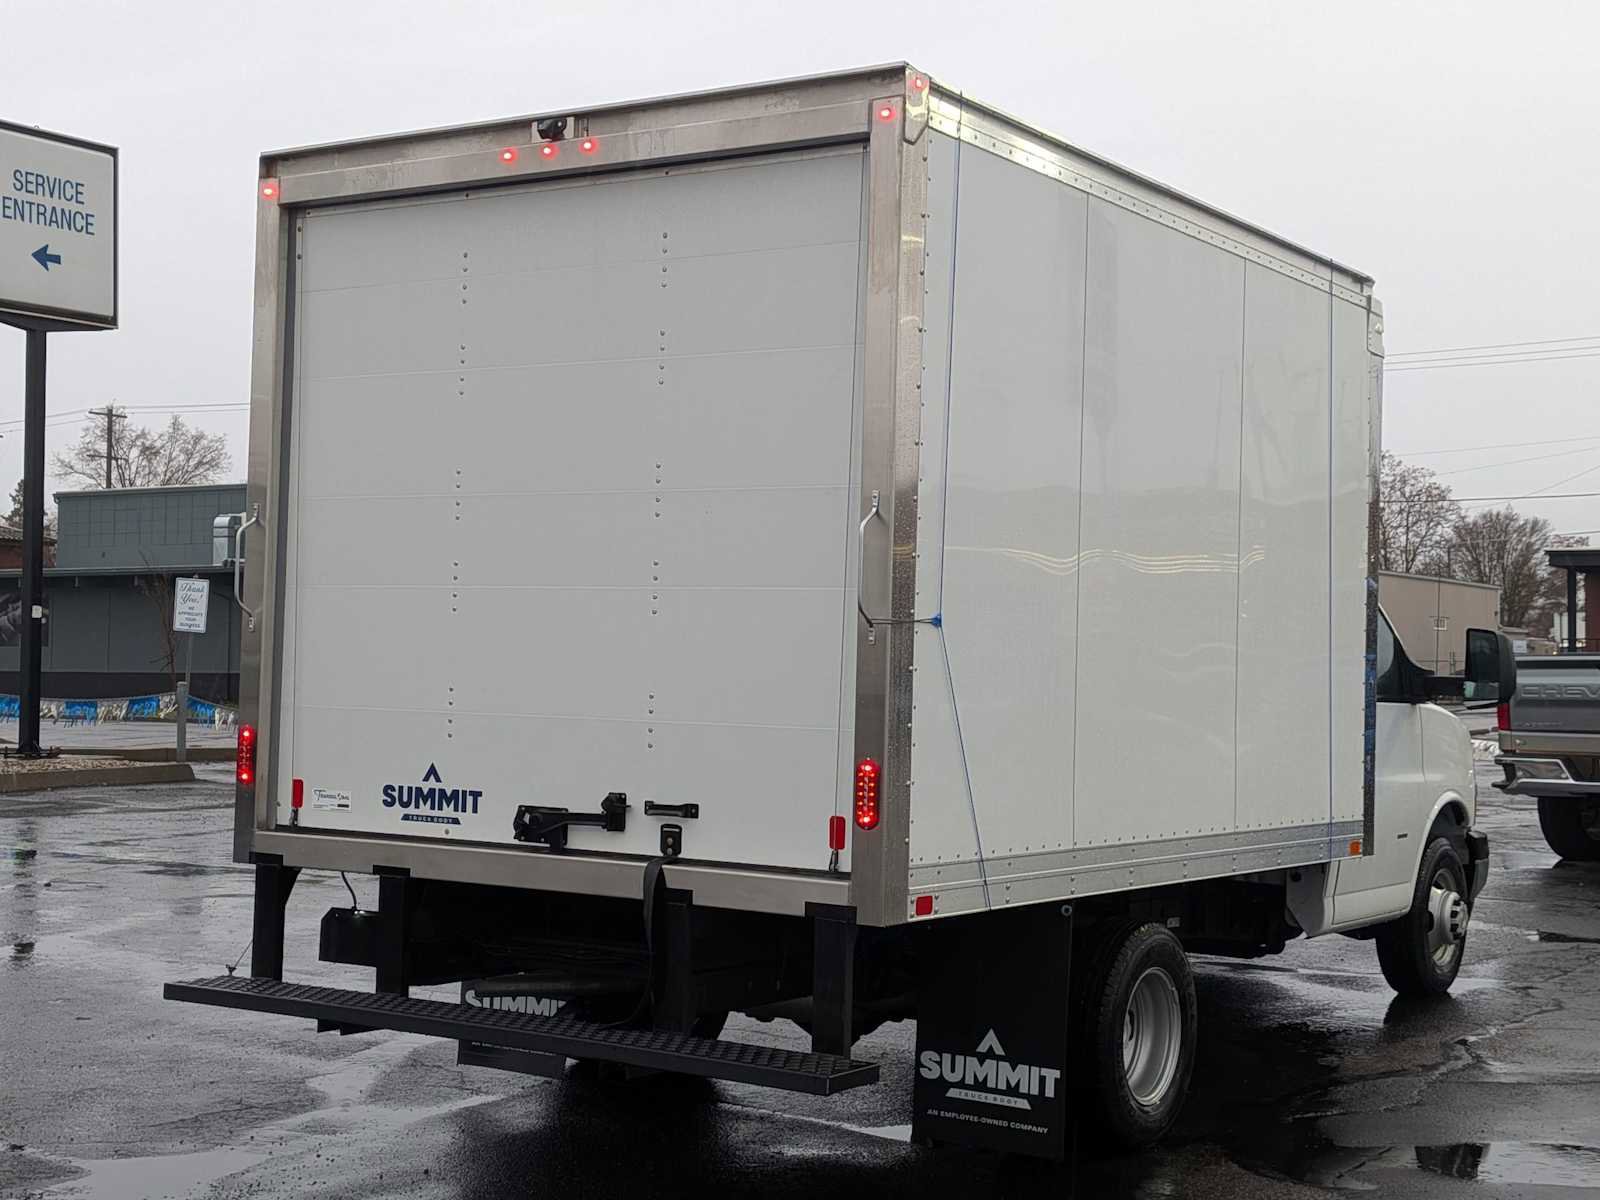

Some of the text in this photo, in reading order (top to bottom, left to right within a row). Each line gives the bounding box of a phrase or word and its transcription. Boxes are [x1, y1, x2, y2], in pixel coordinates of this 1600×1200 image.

[13, 169, 85, 205] SERVICE
[2, 196, 95, 236] ENTRANCE
[382, 784, 483, 814] SUMMIT
[409, 815, 432, 823] TRUCK
[919, 1050, 1061, 1098] SUMMIT
[958, 1090, 1019, 1106] TRUCK BODY
[940, 1110, 1009, 1127] EMPLOYEE-OWNED
[1010, 1121, 1049, 1134] COMPANY
